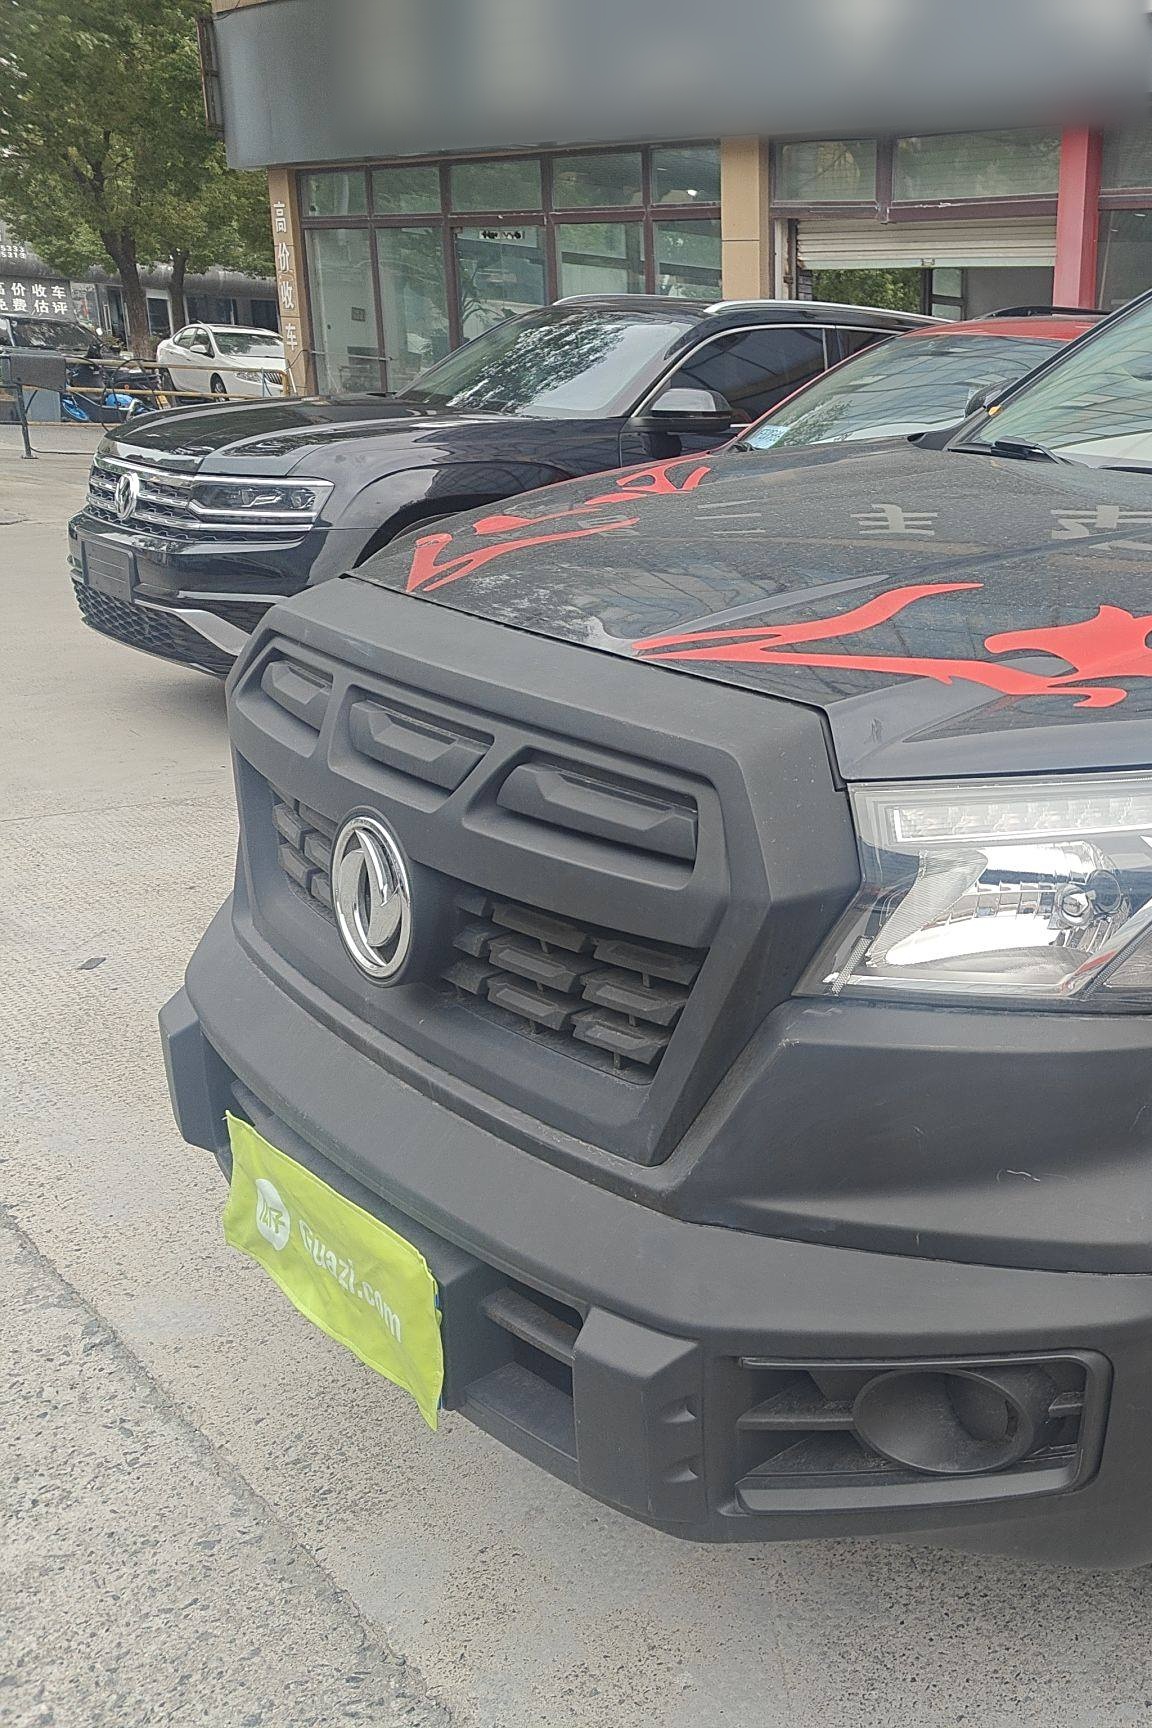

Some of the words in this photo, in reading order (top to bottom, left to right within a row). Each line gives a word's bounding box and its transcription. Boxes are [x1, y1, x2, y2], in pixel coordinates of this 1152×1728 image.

[273, 201, 298, 351] 高价收车
[298, 1218, 402, 1343] Guazi.com
